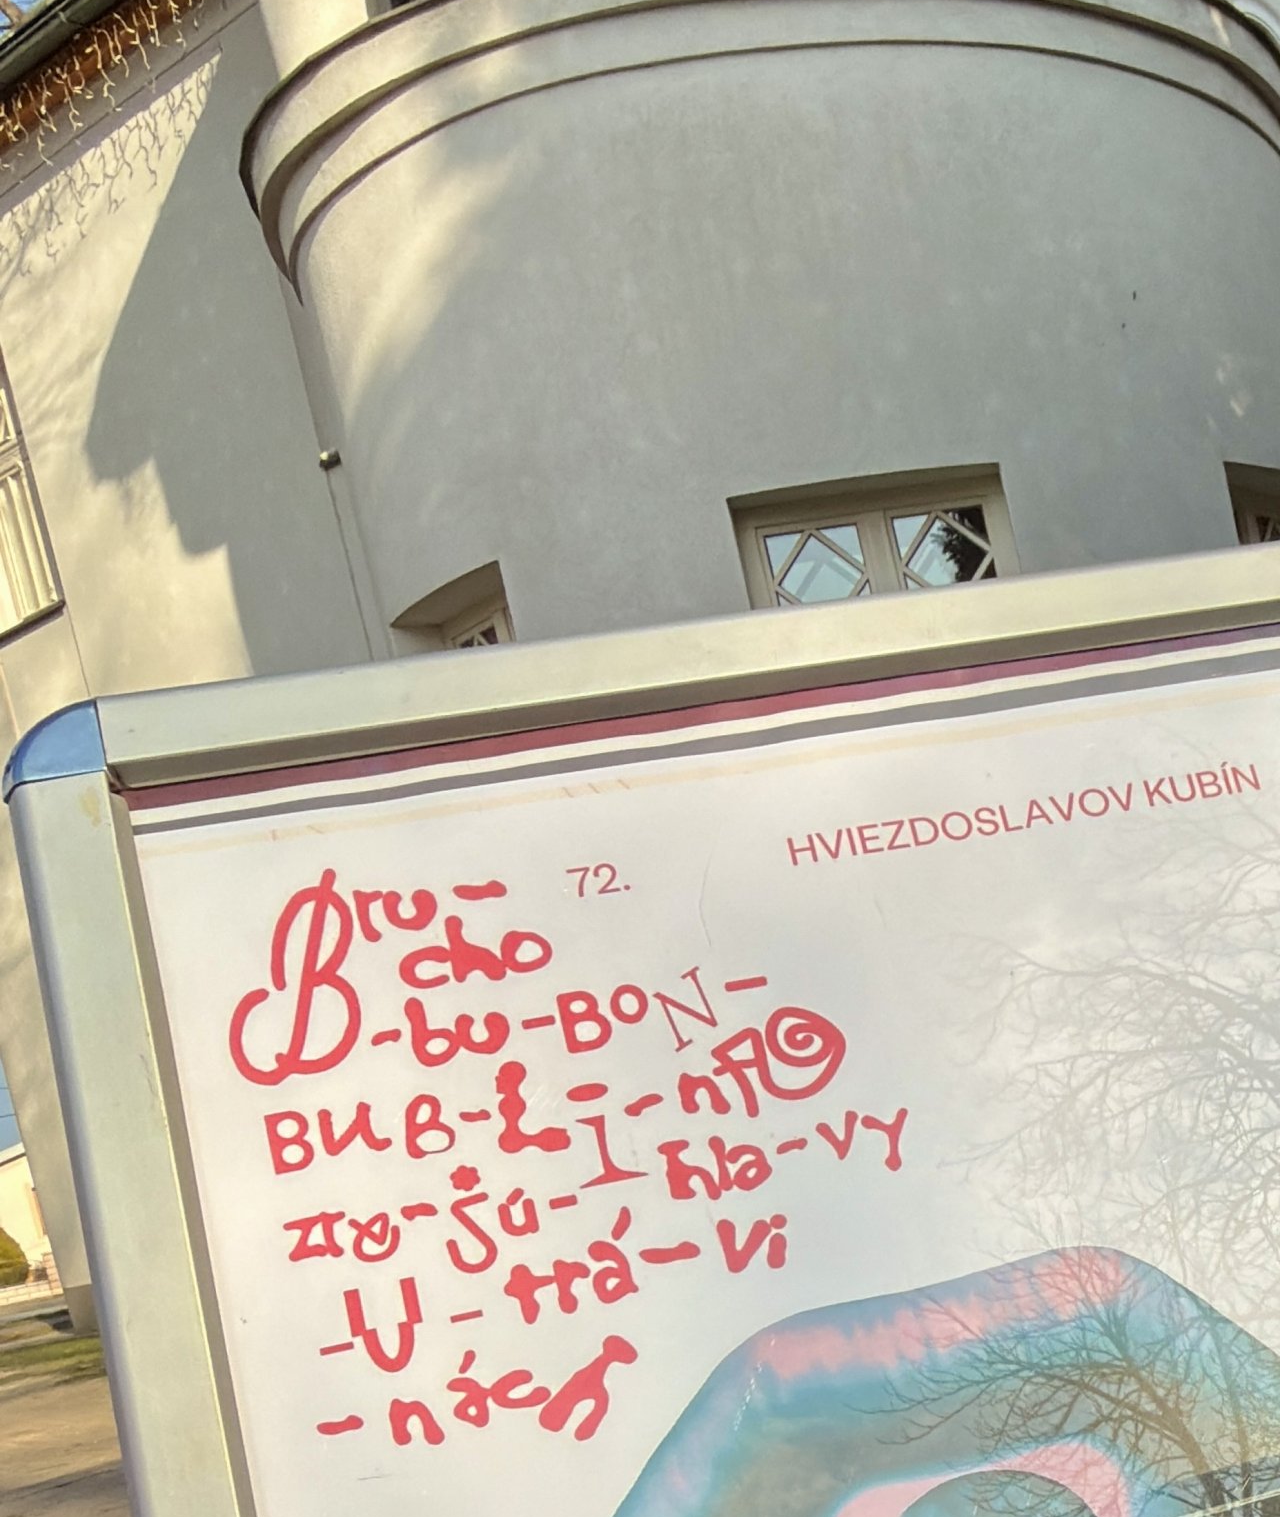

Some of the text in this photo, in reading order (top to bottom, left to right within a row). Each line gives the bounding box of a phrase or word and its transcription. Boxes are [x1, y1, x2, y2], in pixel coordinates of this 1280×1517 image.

[565, 761, 1262, 898] 72. HVIEZDOSLAVOV KUBÍN
